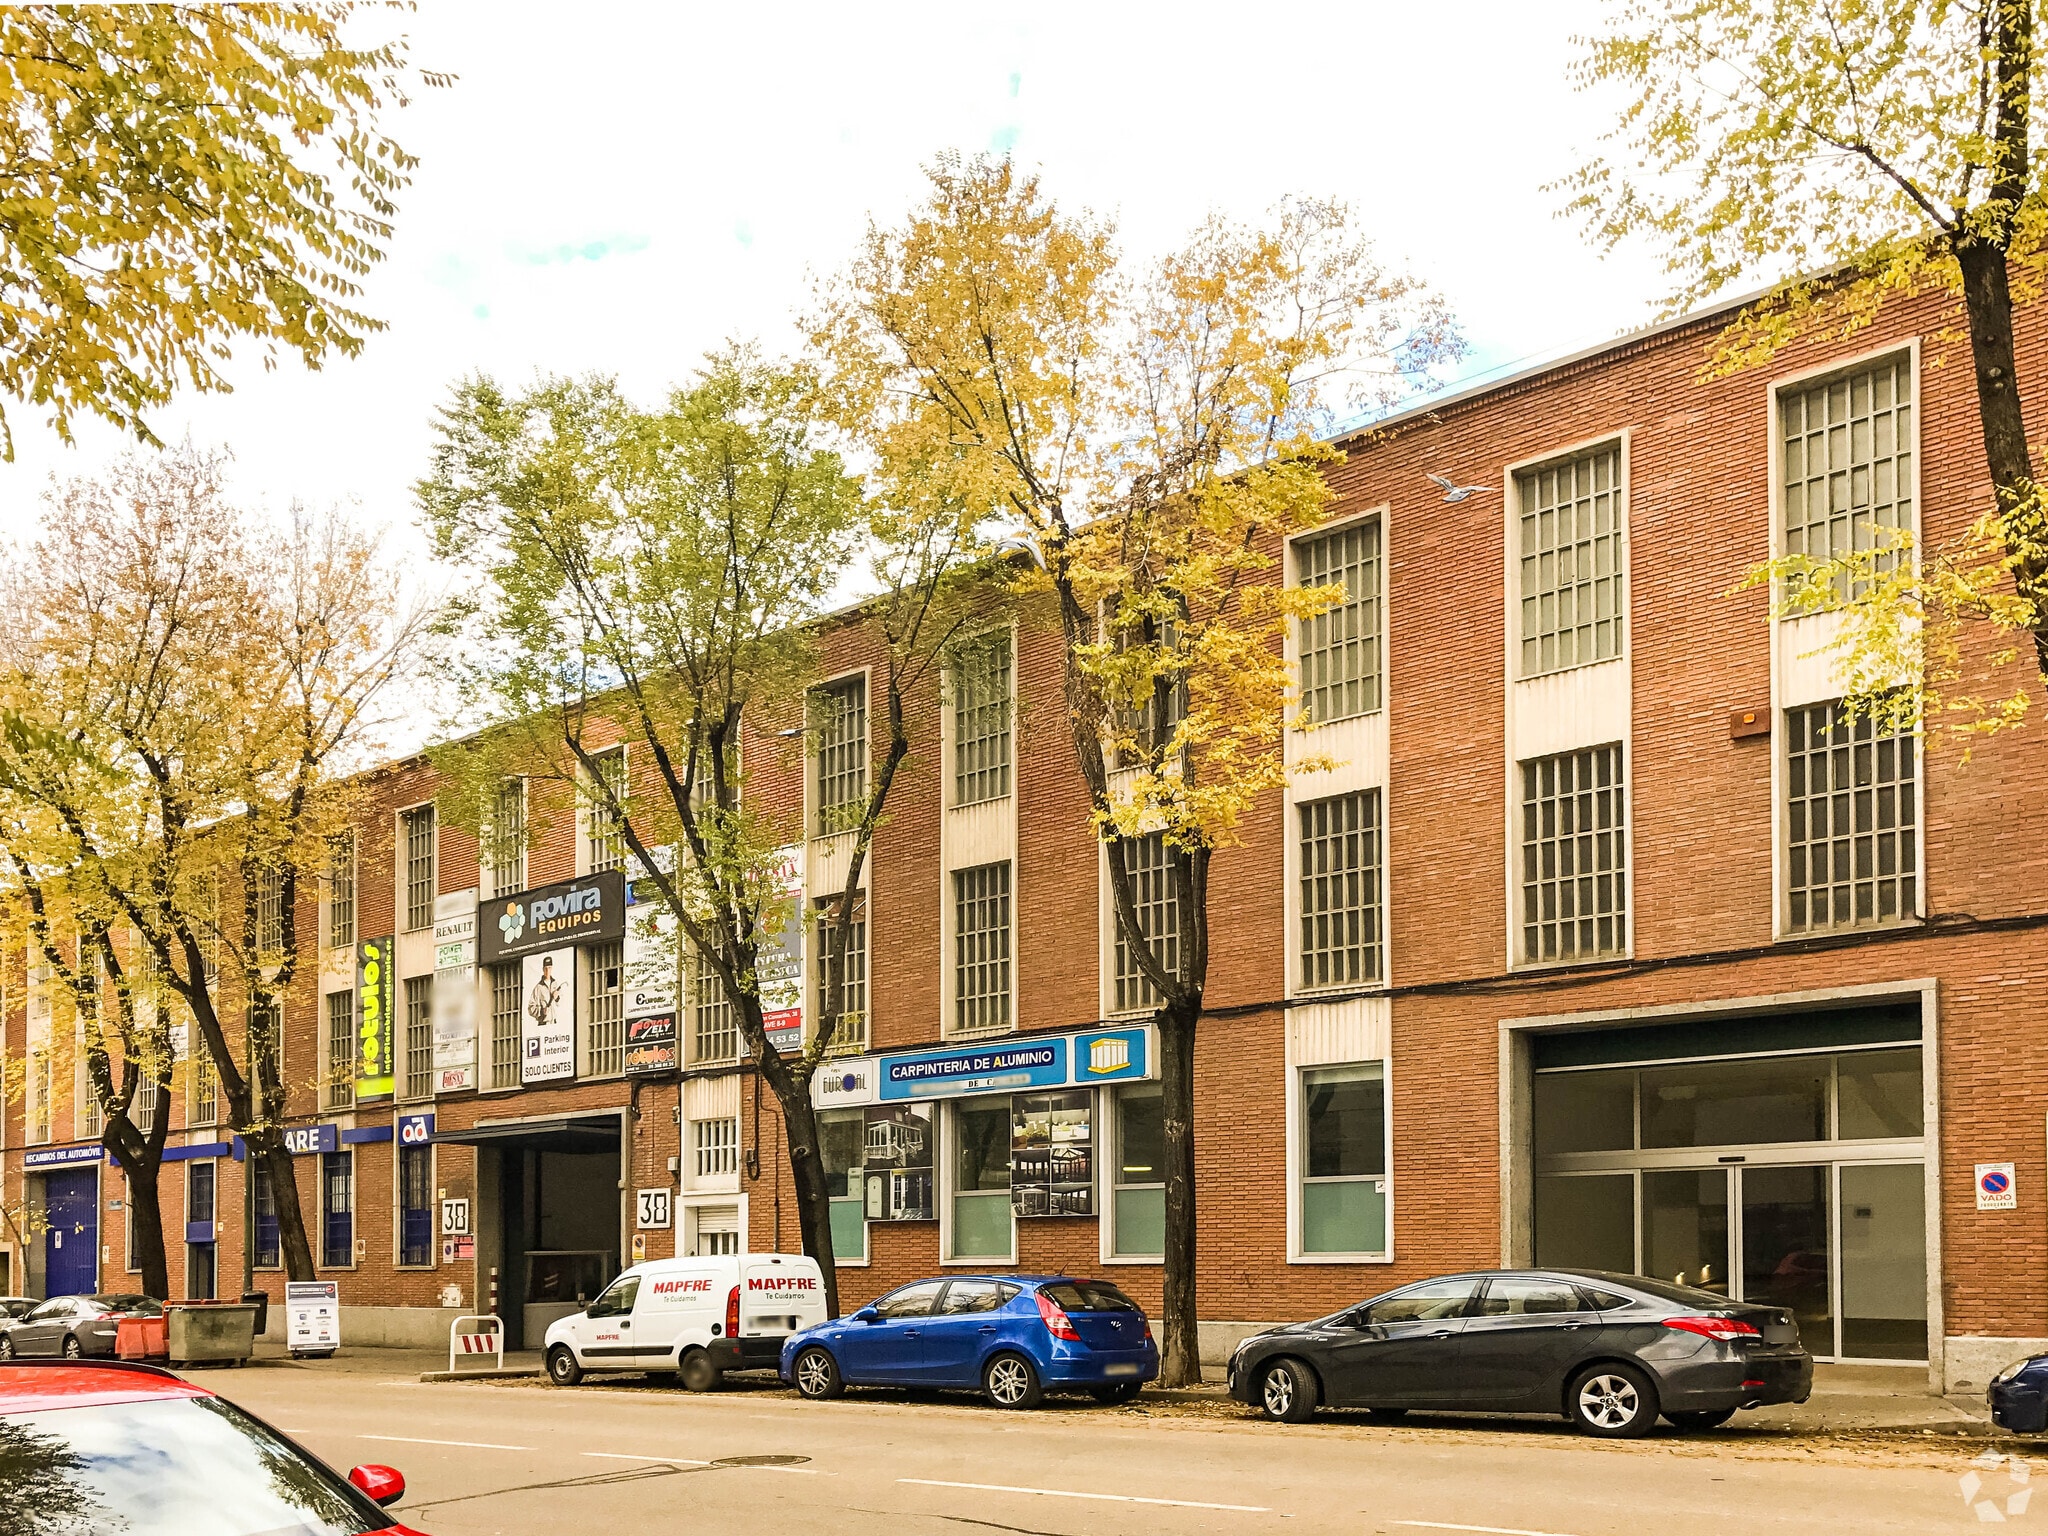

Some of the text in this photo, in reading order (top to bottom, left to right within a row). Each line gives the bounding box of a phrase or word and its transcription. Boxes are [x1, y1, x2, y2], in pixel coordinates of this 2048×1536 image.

[436, 921, 473, 938] RENAULT
[539, 909, 602, 935] EQUIPOS
[764, 1020, 776, 1029] AVE
[544, 1034, 570, 1044] Parking
[776, 1035, 787, 1043] 53
[788, 1033, 800, 1042] 52
[529, 1040, 539, 1057] P
[544, 1046, 569, 1056] Interior
[525, 1061, 572, 1077] SOLO CLIENTES
[891, 1057, 971, 1080] CARPINTERIA
[974, 1057, 991, 1070] DE
[993, 1050, 1052, 1068] ALUMINIO
[968, 1080, 979, 1088] DE
[285, 1129, 319, 1153] ARE
[26, 1146, 101, 1163] RECAMBIOS DEL AUTOMÓVIL
[640, 1193, 667, 1224] 38
[445, 1203, 466, 1230] 38
[653, 1279, 713, 1294] MAPFRE
[748, 1278, 817, 1290] MAPFRE
[670, 1295, 697, 1303] Cuidamos
[774, 1292, 805, 1300] Cuidamos
[596, 1333, 620, 1341] MAPFRE
